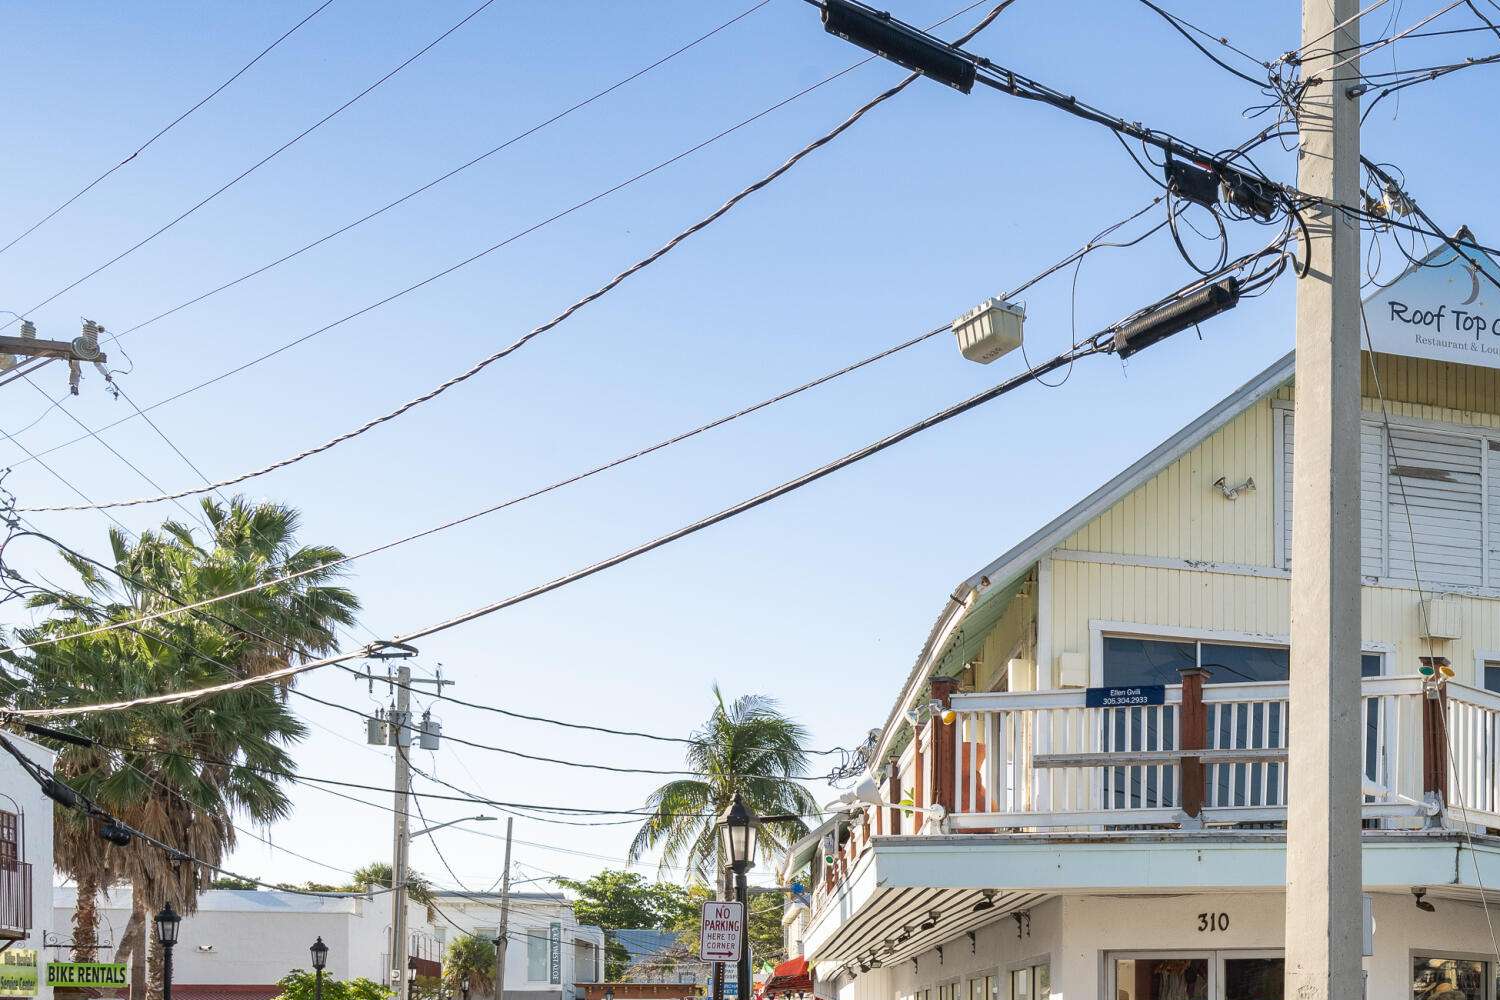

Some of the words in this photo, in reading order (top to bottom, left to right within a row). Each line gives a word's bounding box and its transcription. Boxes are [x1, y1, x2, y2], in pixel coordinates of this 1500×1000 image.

[1388, 300, 1446, 332] Roof
[1451, 310, 1487, 340] Top
[1415, 334, 1468, 351] Restaurant
[1470, 342, 1478, 351] &
[1103, 696, 1148, 705] 305.304.2933
[715, 907, 730, 919] NO
[704, 920, 739, 931] PARKING
[1197, 912, 1229, 932] 310
[706, 941, 735, 949] CORNER
[48, 966, 74, 982] BIKE
[78, 967, 126, 983] RENTALS
